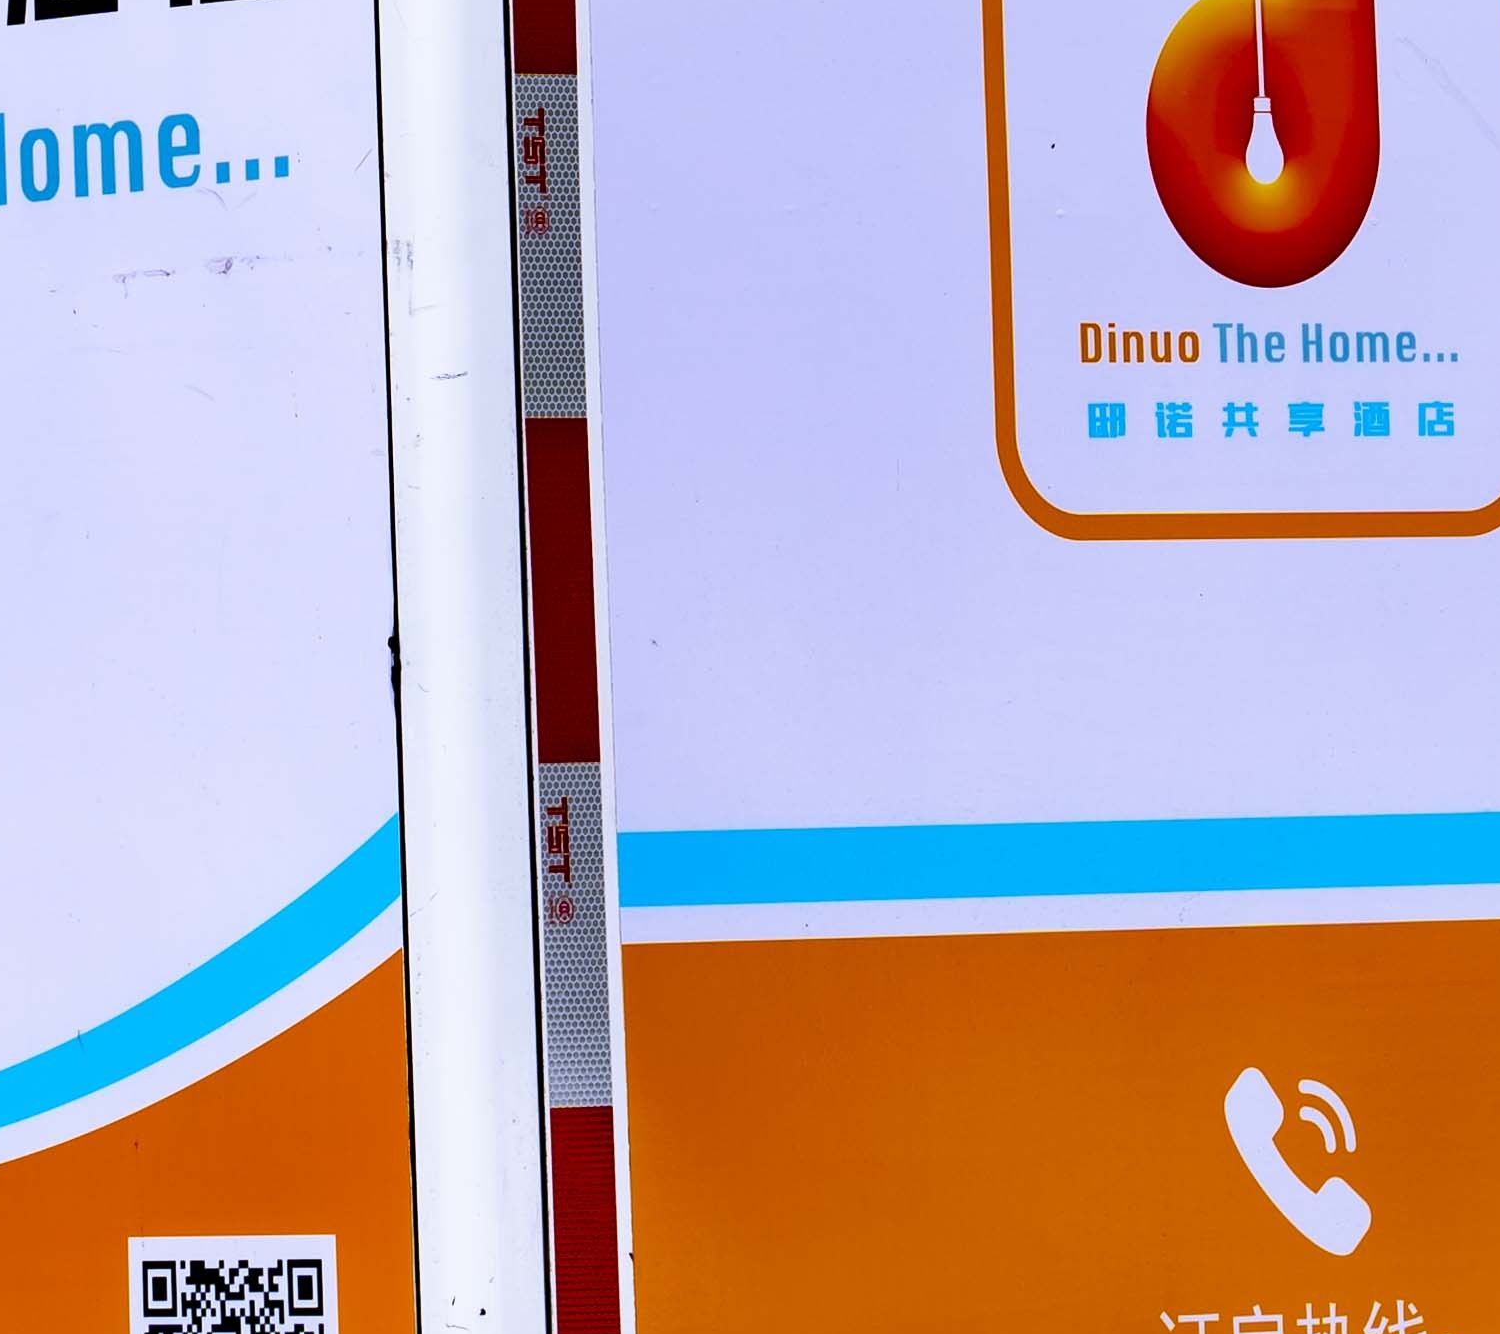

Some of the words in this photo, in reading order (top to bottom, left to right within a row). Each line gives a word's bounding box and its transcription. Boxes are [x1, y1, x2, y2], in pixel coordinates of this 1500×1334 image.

[523, 106, 547, 194] TST
[1079, 321, 1201, 365] Dinuo
[1211, 321, 1287, 365] The
[1300, 321, 1461, 365] Home...
[1085, 398, 1457, 442] 邸诺共享酒店
[546, 796, 571, 883] TST
